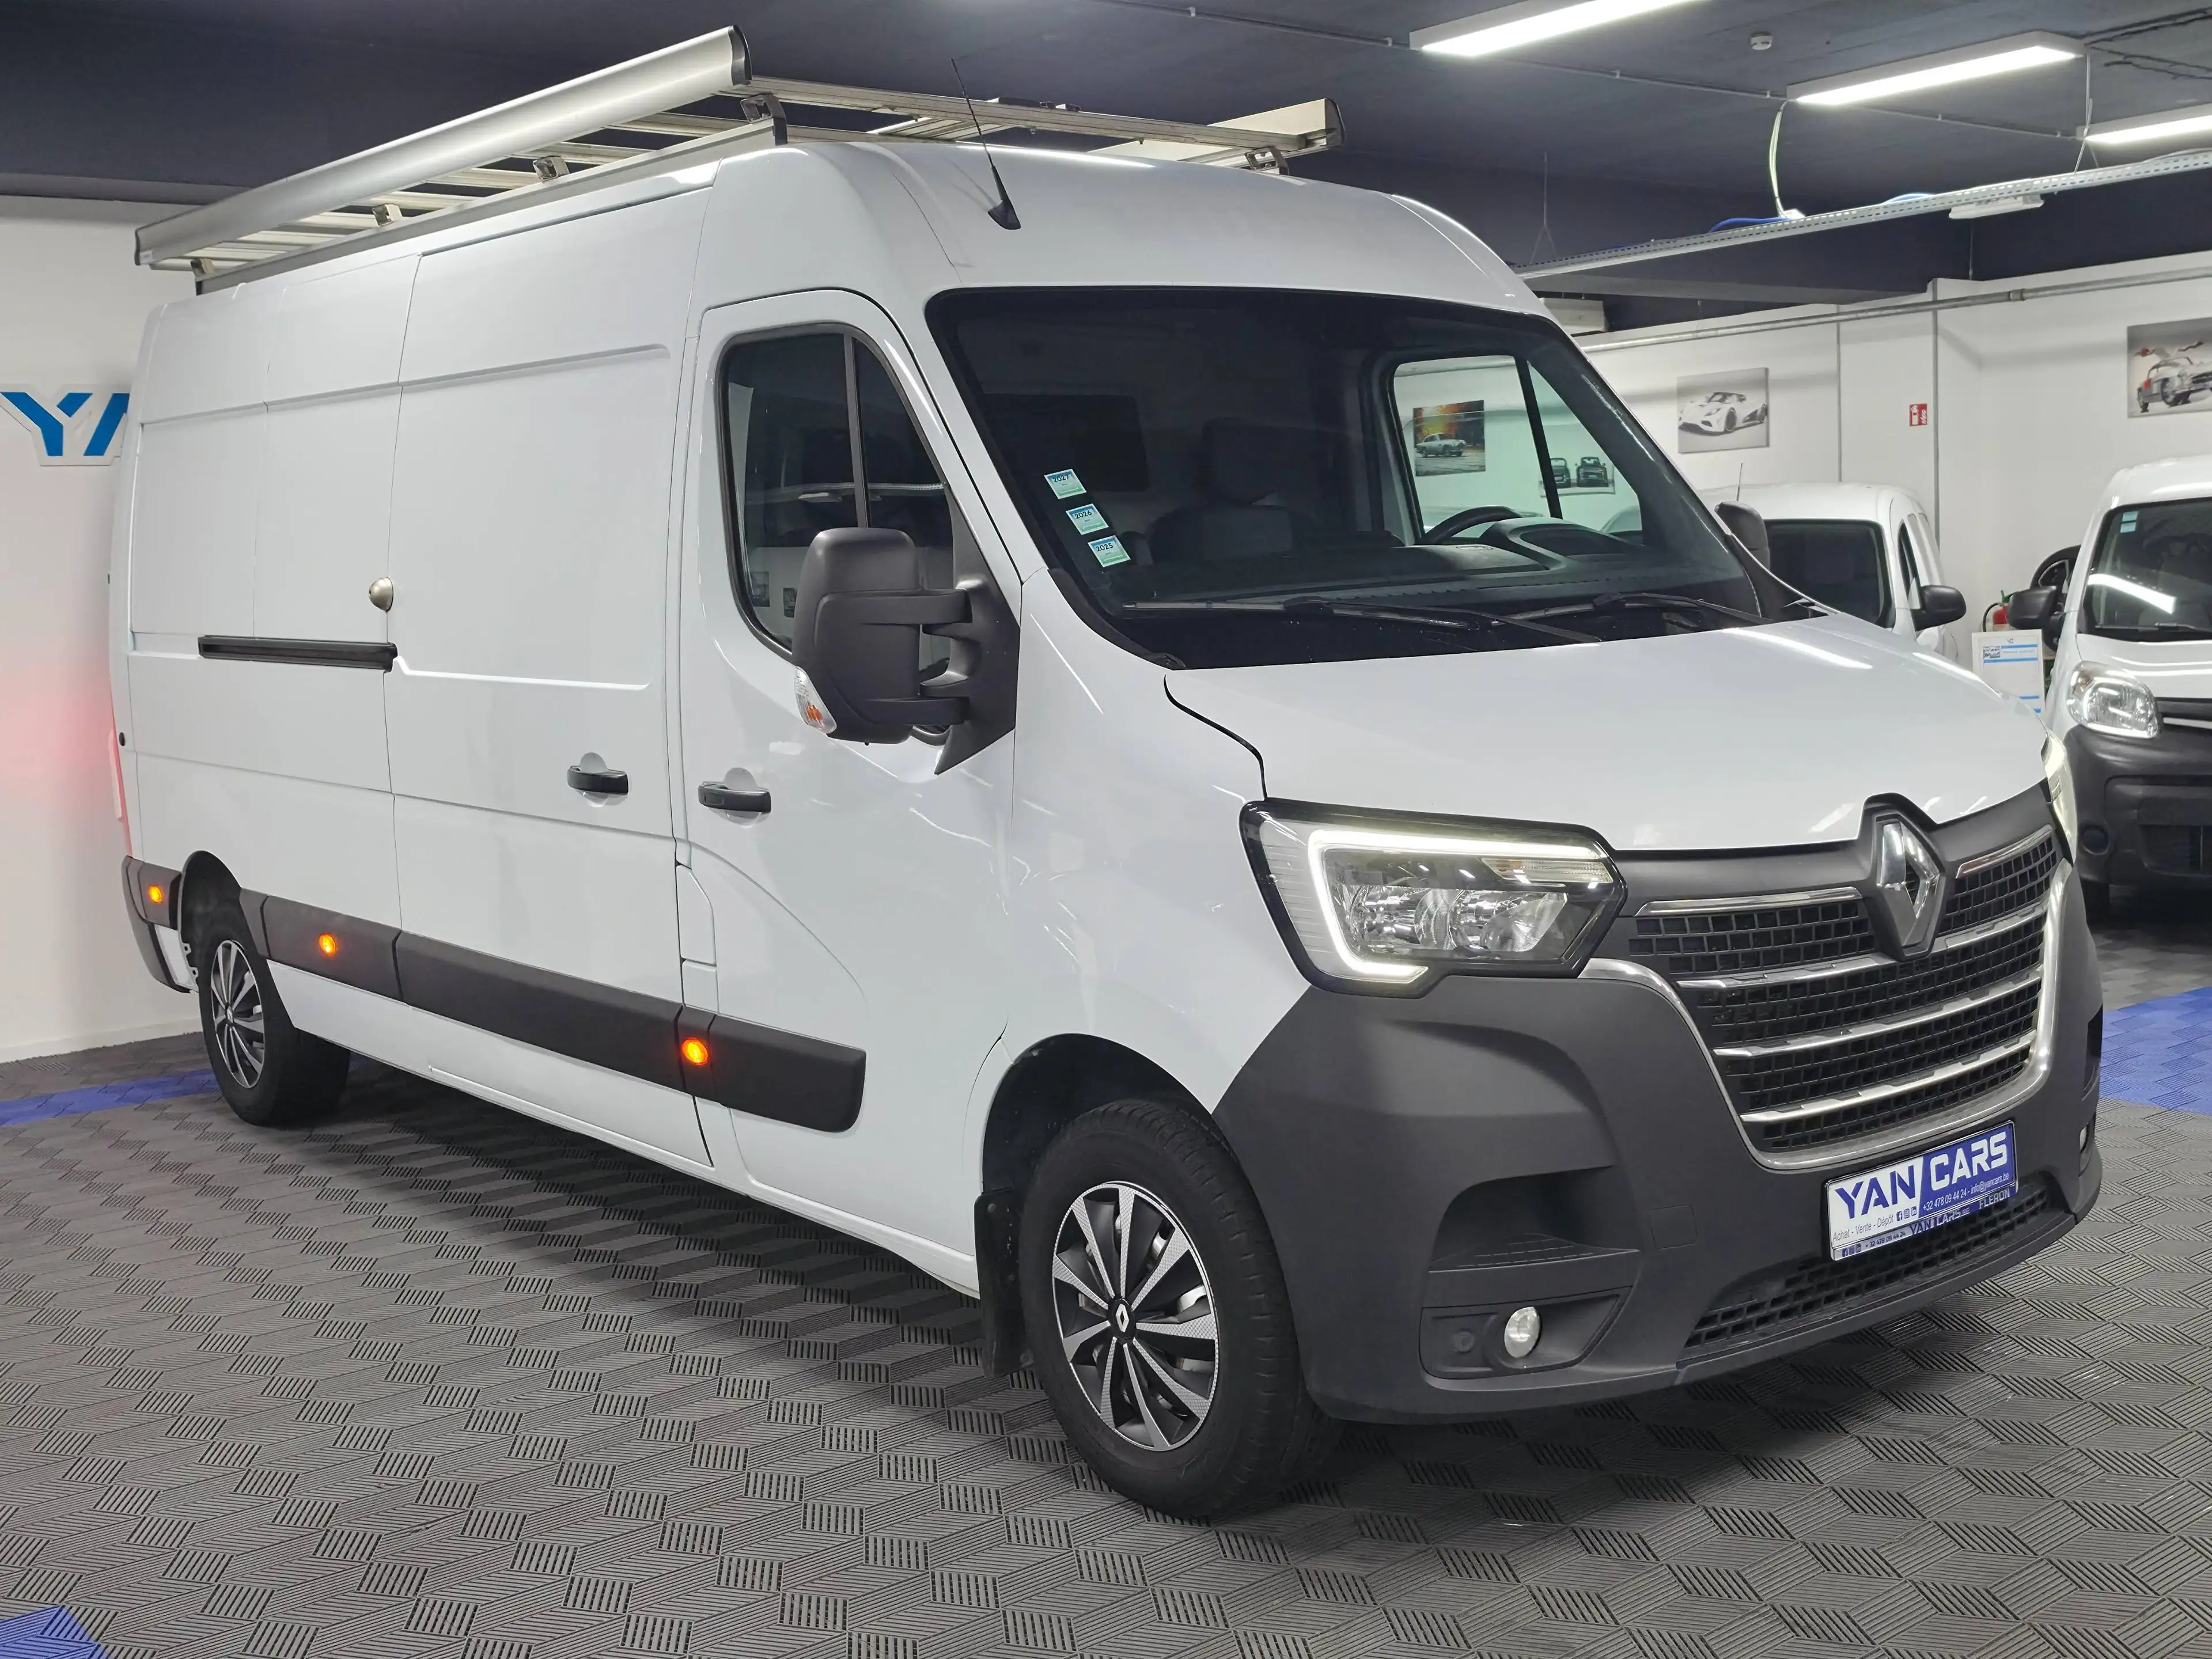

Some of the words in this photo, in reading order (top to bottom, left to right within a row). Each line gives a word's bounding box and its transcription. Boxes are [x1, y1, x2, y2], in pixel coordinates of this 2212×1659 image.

[1052, 474, 1069, 483] 2027
[1074, 510, 1092, 519] 2026
[1096, 543, 1113, 552] 2025
[1835, 1165, 1916, 1219] YAN
[1930, 1131, 2008, 1191] CARS
[1923, 1200, 1933, 1211] +32
[1934, 1196, 1944, 1207] 478
[1945, 1194, 1952, 1204] 09
[1953, 1190, 1959, 1200] 44
[1960, 1188, 1967, 1198] 24
[1979, 1188, 2010, 1209] FLERON
[1832, 1229, 1850, 1242] Achat
[1855, 1223, 1872, 1235] Vente
[1877, 1214, 1895, 1229] Dépôt
[1910, 1218, 1931, 1234] YAN
